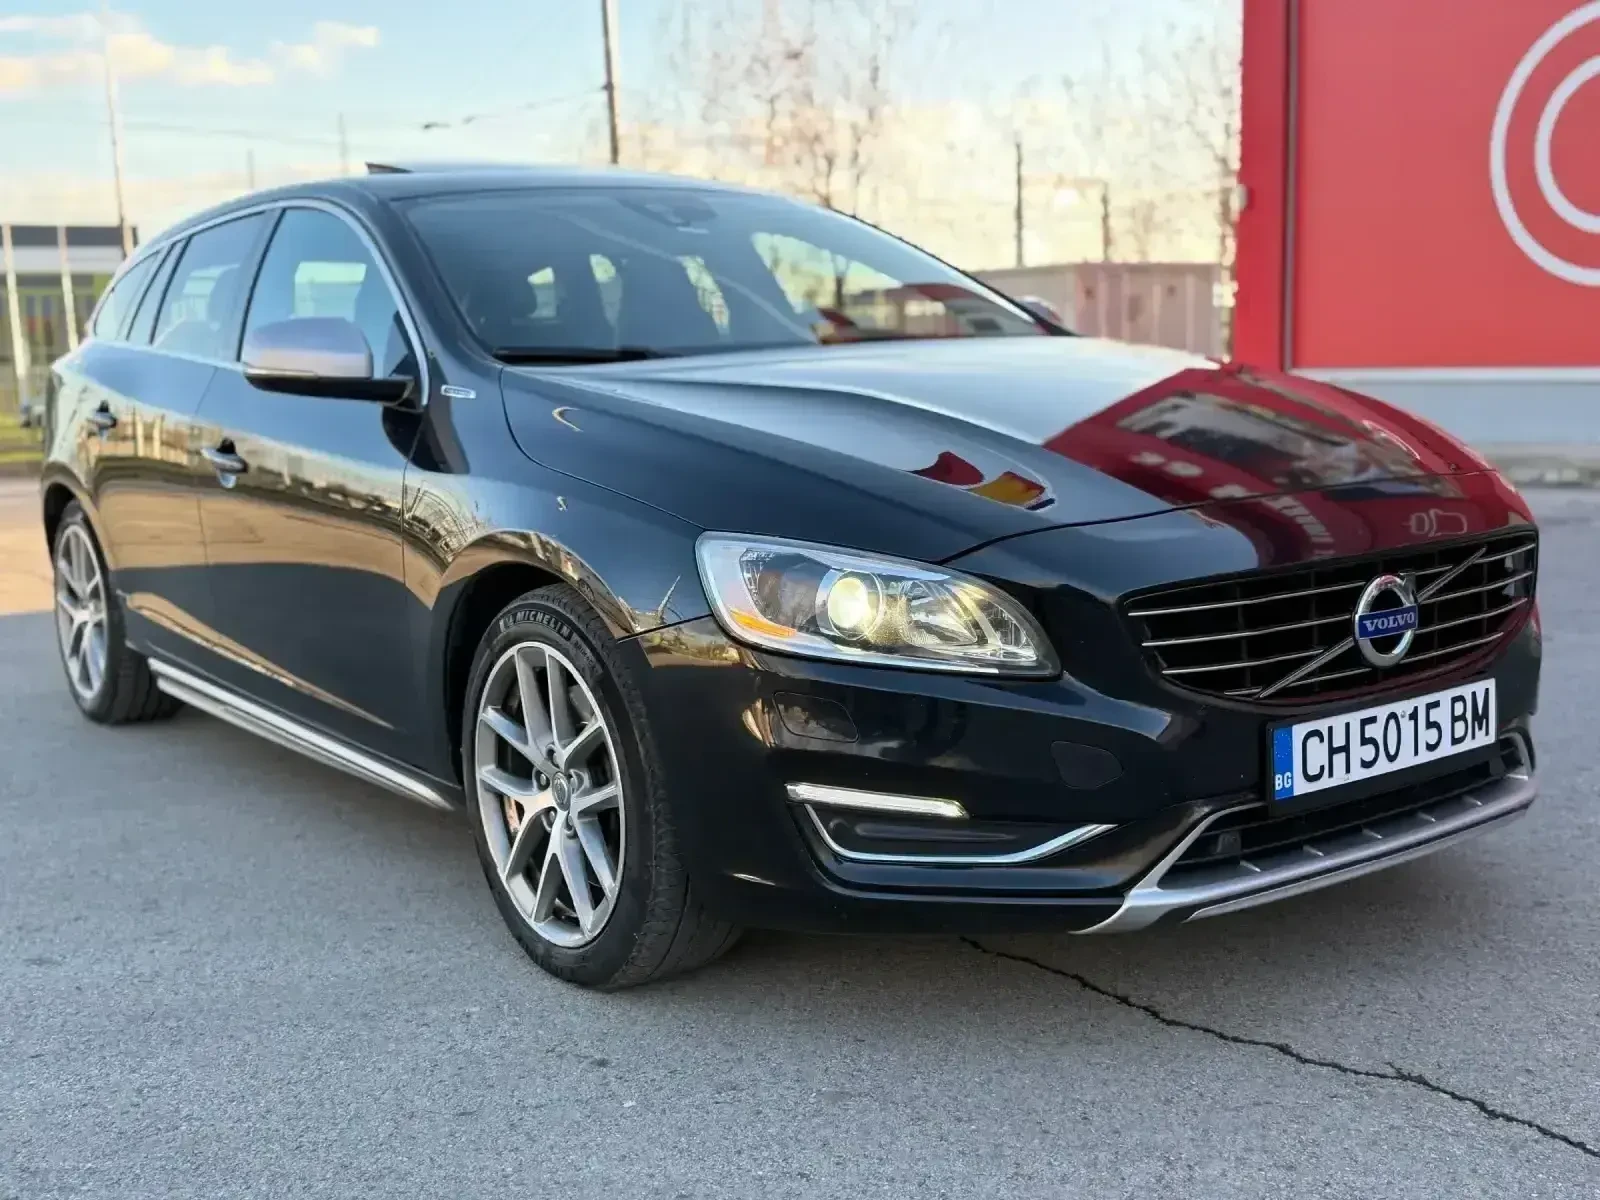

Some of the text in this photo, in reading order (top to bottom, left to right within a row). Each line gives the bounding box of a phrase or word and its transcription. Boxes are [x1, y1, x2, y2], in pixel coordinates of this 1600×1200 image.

[515, 610, 571, 637] MICHELIN
[1363, 612, 1415, 632] VOLVO
[1275, 771, 1292, 791] BG
